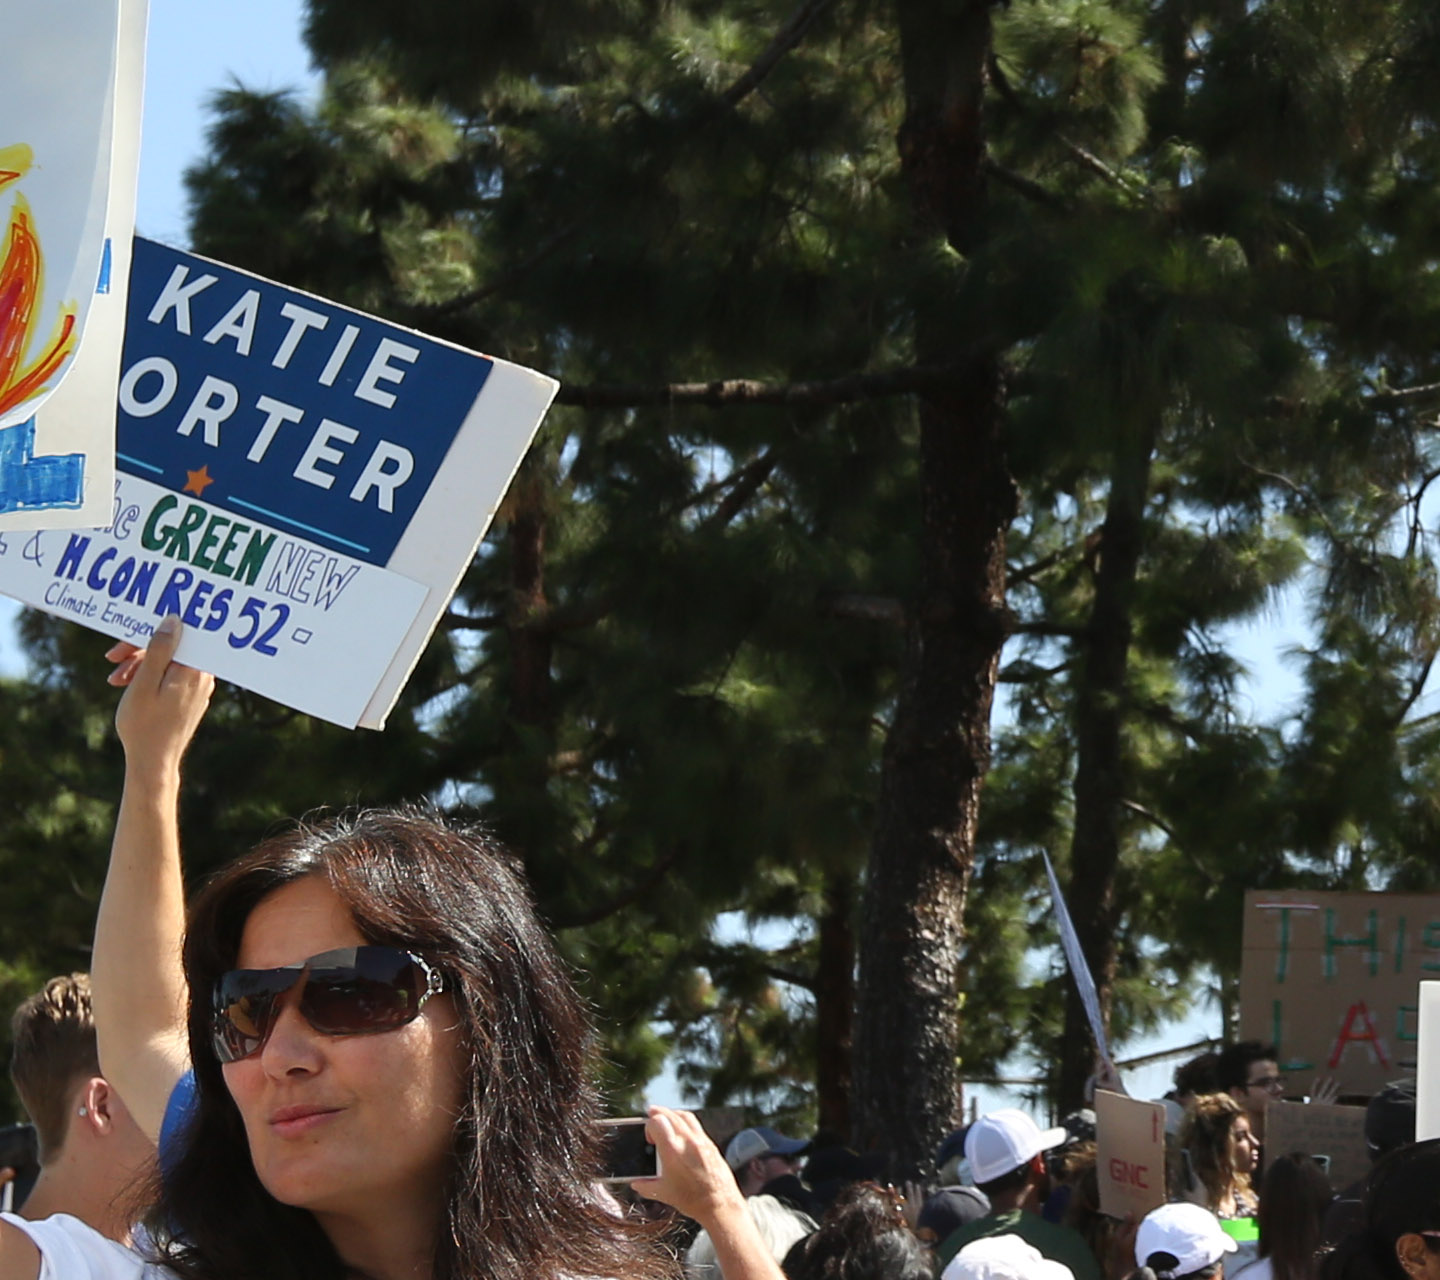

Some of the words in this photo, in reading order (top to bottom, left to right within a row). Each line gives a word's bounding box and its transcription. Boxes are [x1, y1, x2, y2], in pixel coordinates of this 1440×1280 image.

[147, 264, 420, 409] KATIE
[119, 356, 415, 513] ORTER
[44, 581, 97, 618] Climate
[101, 602, 155, 638] Emergen
[141, 494, 278, 586] GREEN
[265, 541, 361, 611] NEW
[153, 568, 234, 632] RES
[227, 597, 290, 657] 52
